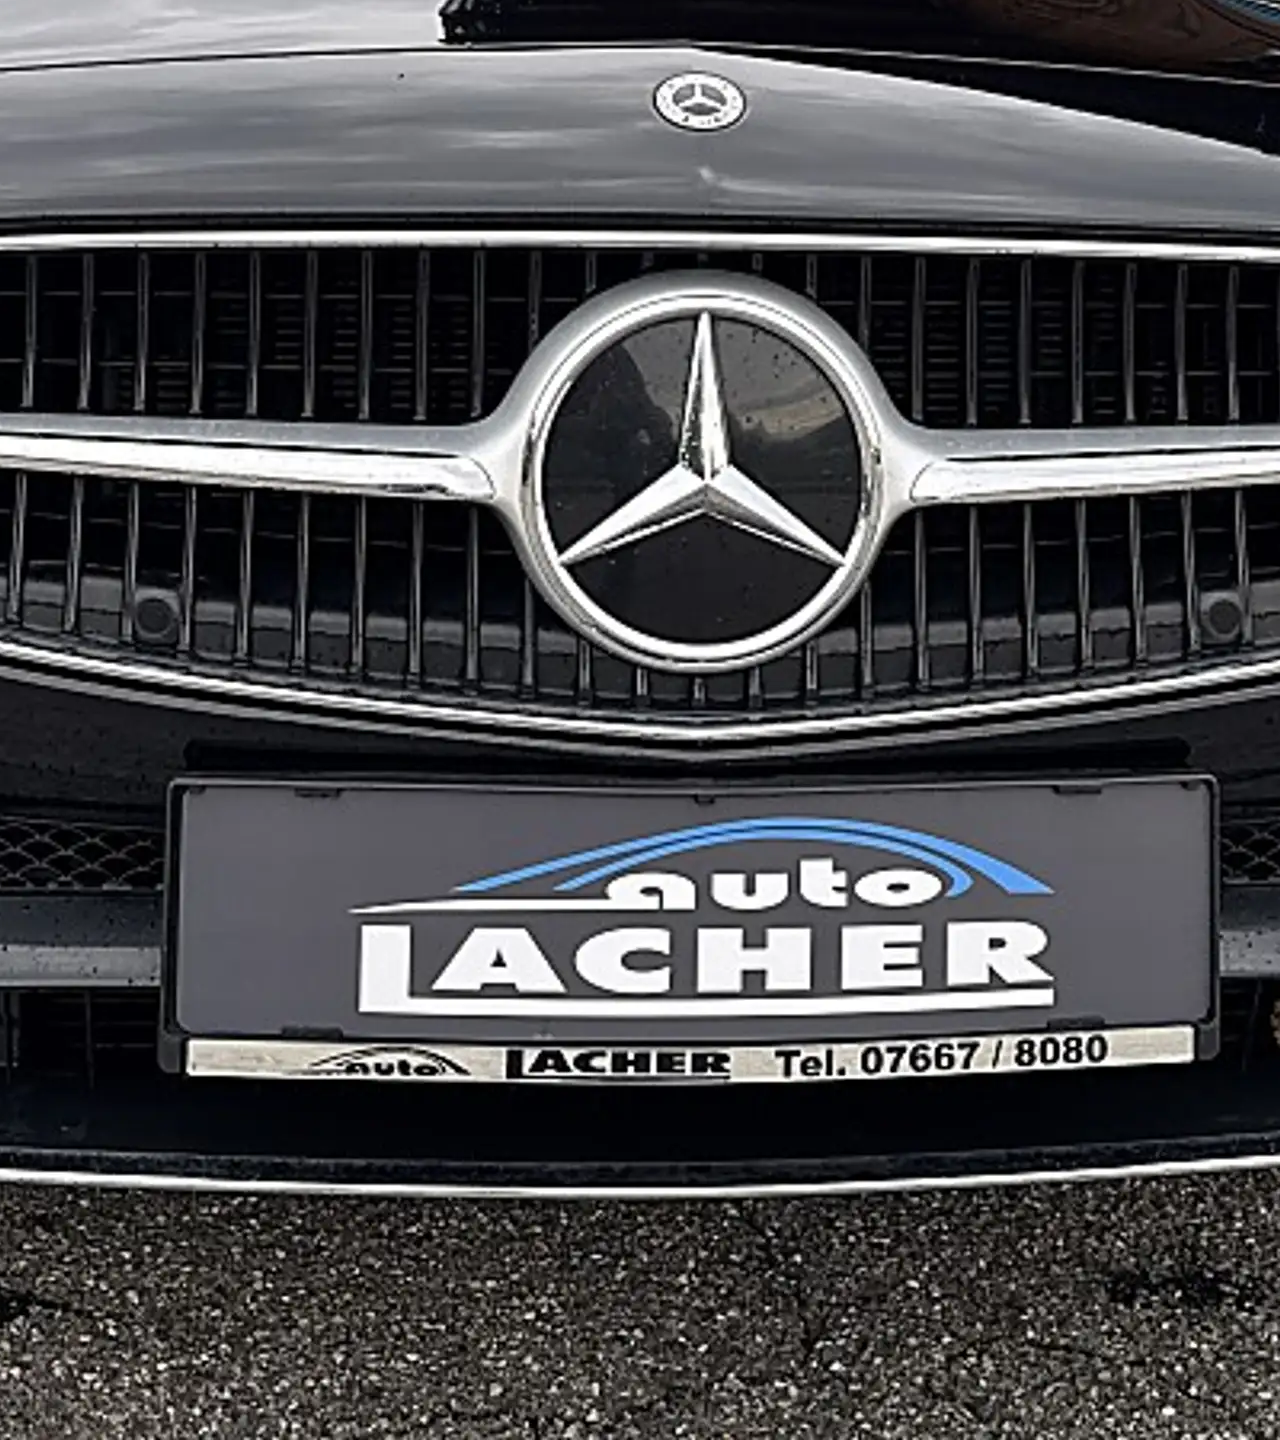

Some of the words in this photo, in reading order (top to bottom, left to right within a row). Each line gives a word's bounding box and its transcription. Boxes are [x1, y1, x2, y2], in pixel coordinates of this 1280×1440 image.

[605, 857, 944, 912] auto
[357, 920, 1056, 1015] LACHER
[346, 1058, 438, 1078] auto
[505, 1048, 732, 1080] LACHER
[774, 1049, 846, 1078] Tel.
[859, 1041, 980, 1074] 07667
[1014, 1034, 1109, 1067] 8080
